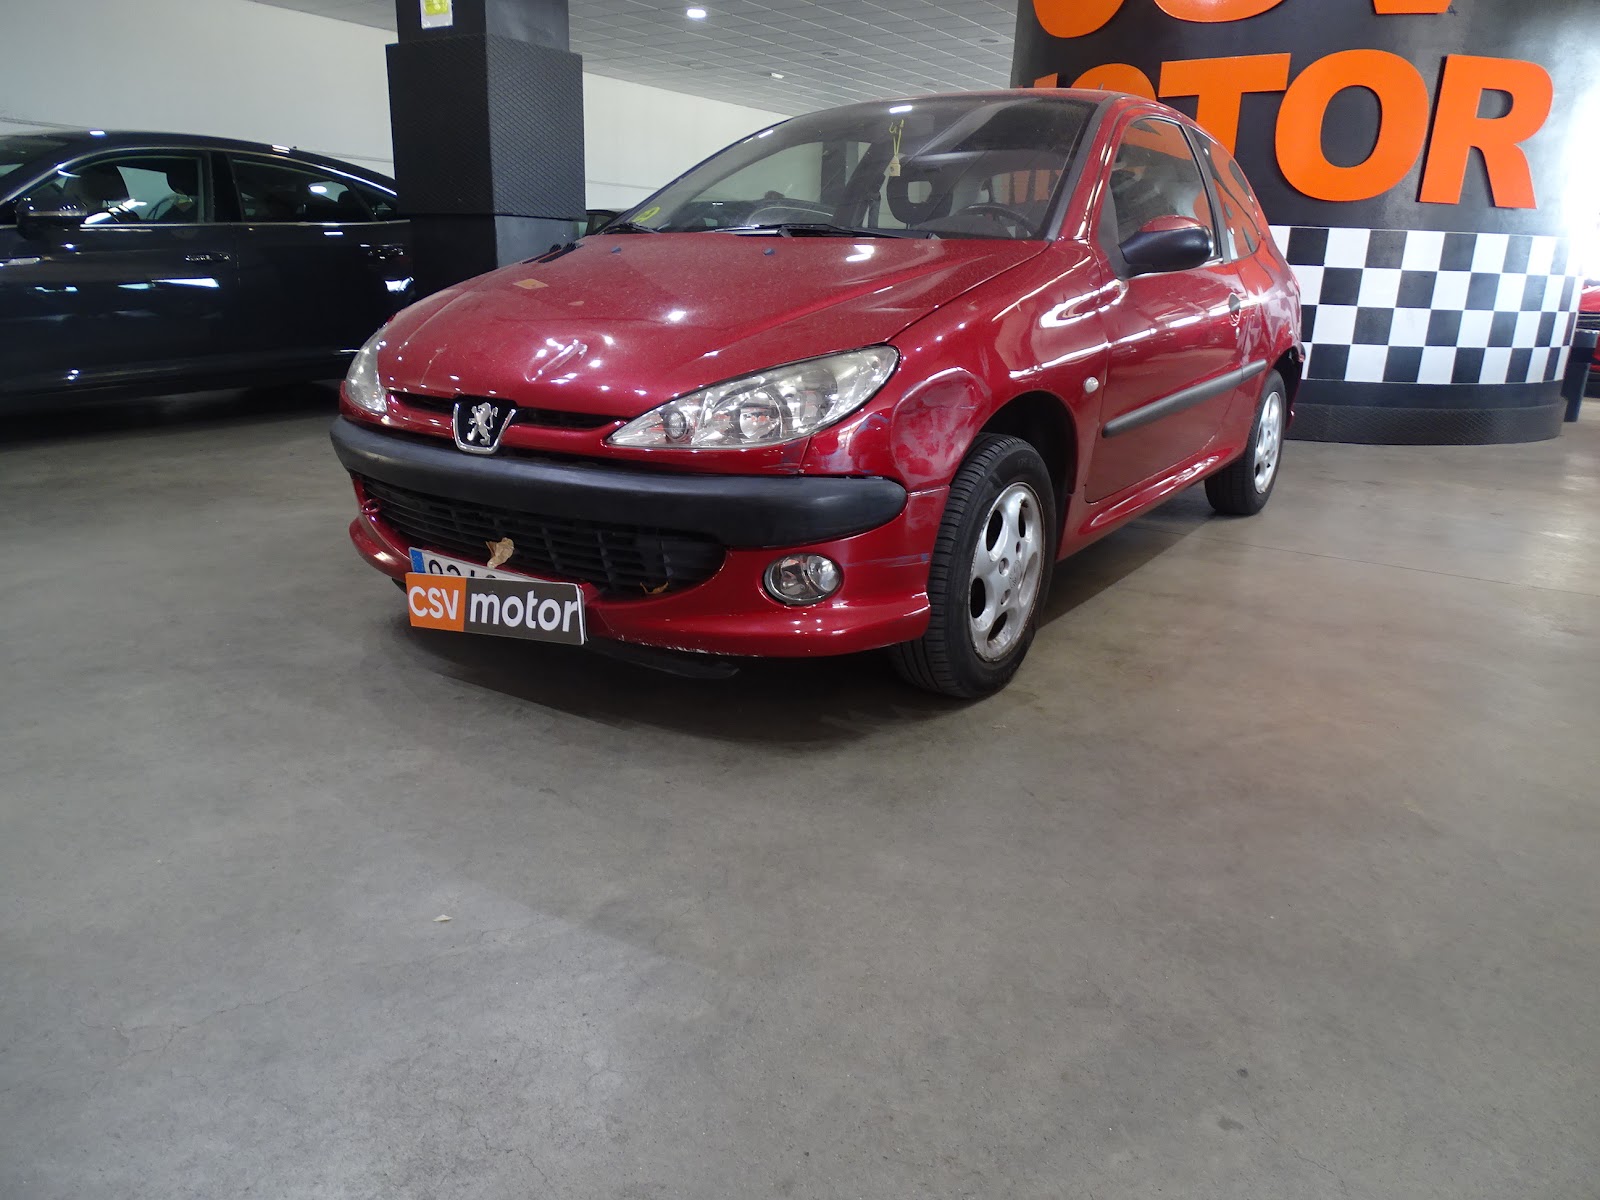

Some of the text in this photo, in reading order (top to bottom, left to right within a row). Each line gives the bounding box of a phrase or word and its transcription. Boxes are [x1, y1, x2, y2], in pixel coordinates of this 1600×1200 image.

[1018, 49, 1554, 209] TOR
[408, 586, 578, 632] CSV motor
